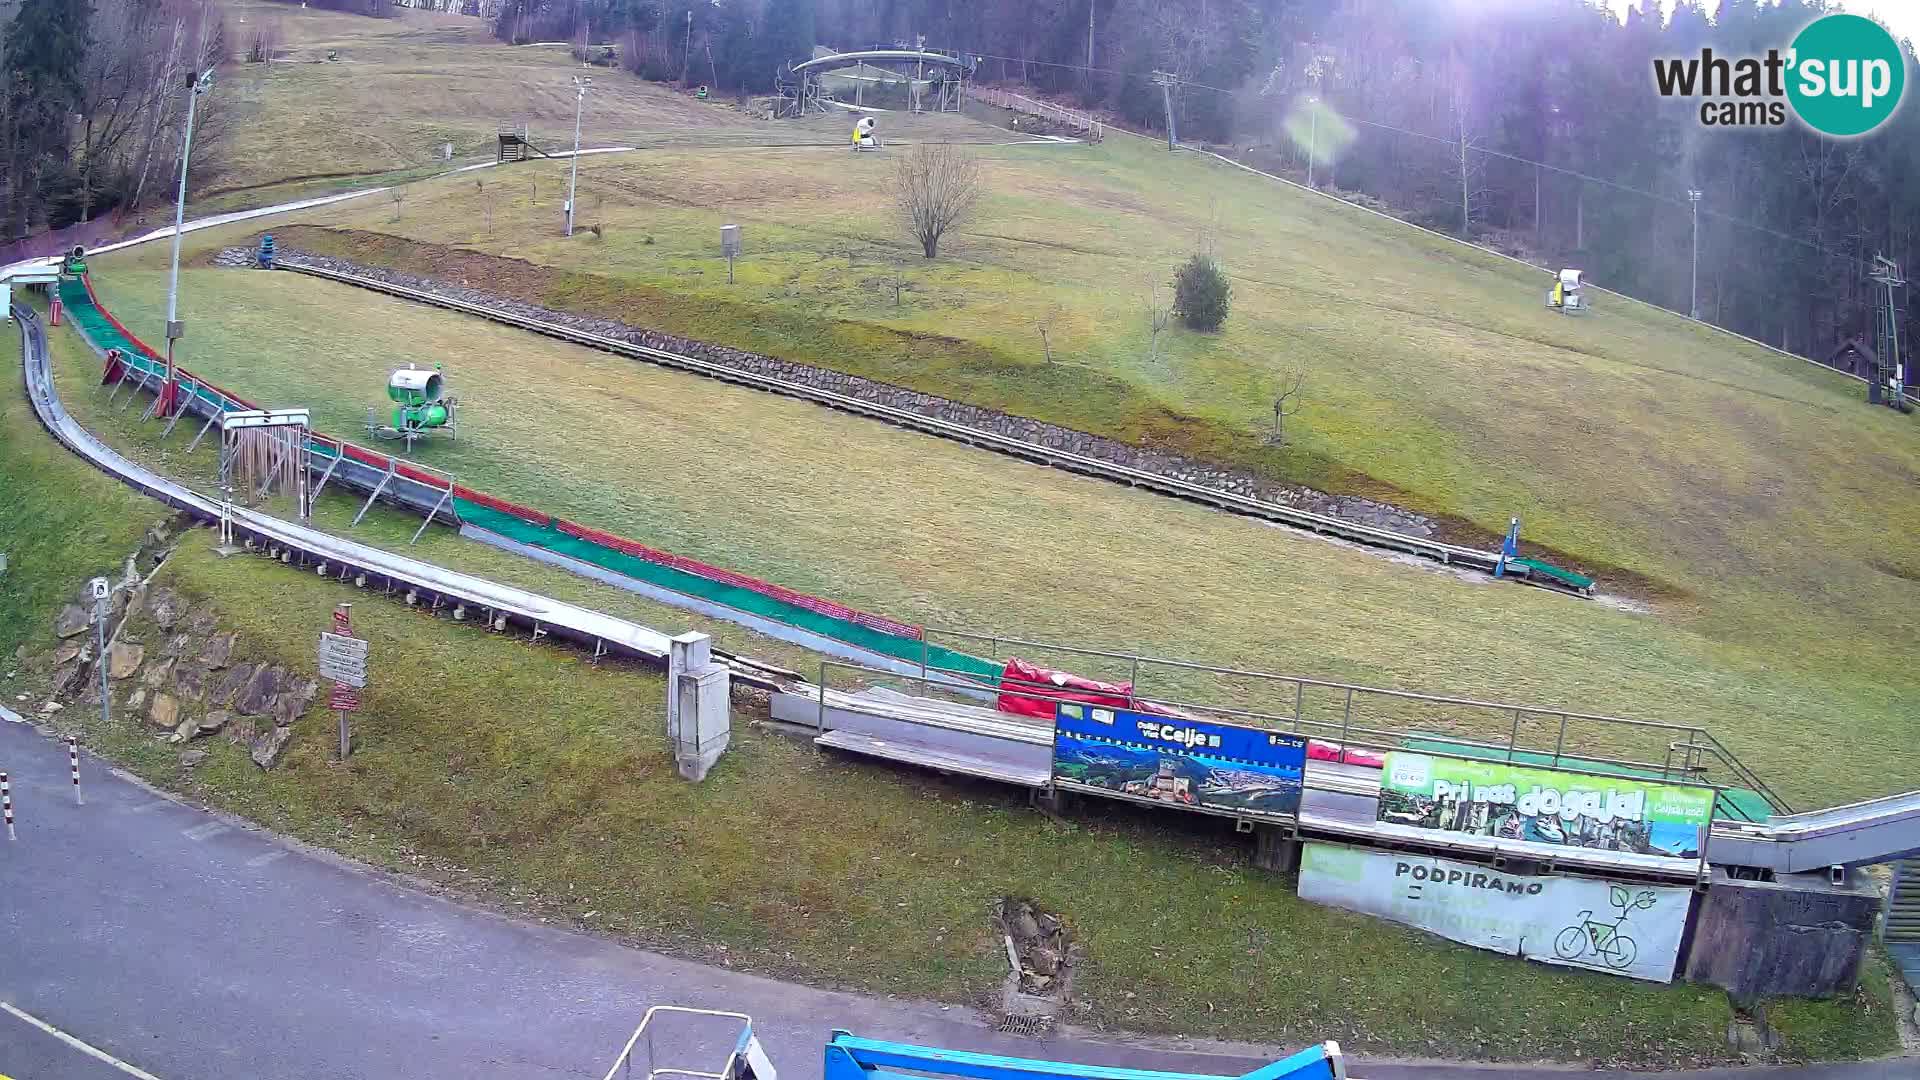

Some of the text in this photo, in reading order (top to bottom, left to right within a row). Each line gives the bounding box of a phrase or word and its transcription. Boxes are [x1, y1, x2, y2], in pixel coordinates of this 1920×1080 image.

[1160, 725, 1207, 748] Celje
[1433, 778, 1470, 802] Pri
[1473, 783, 1517, 805] nas
[1395, 862, 1543, 896] PODPIRAMO
